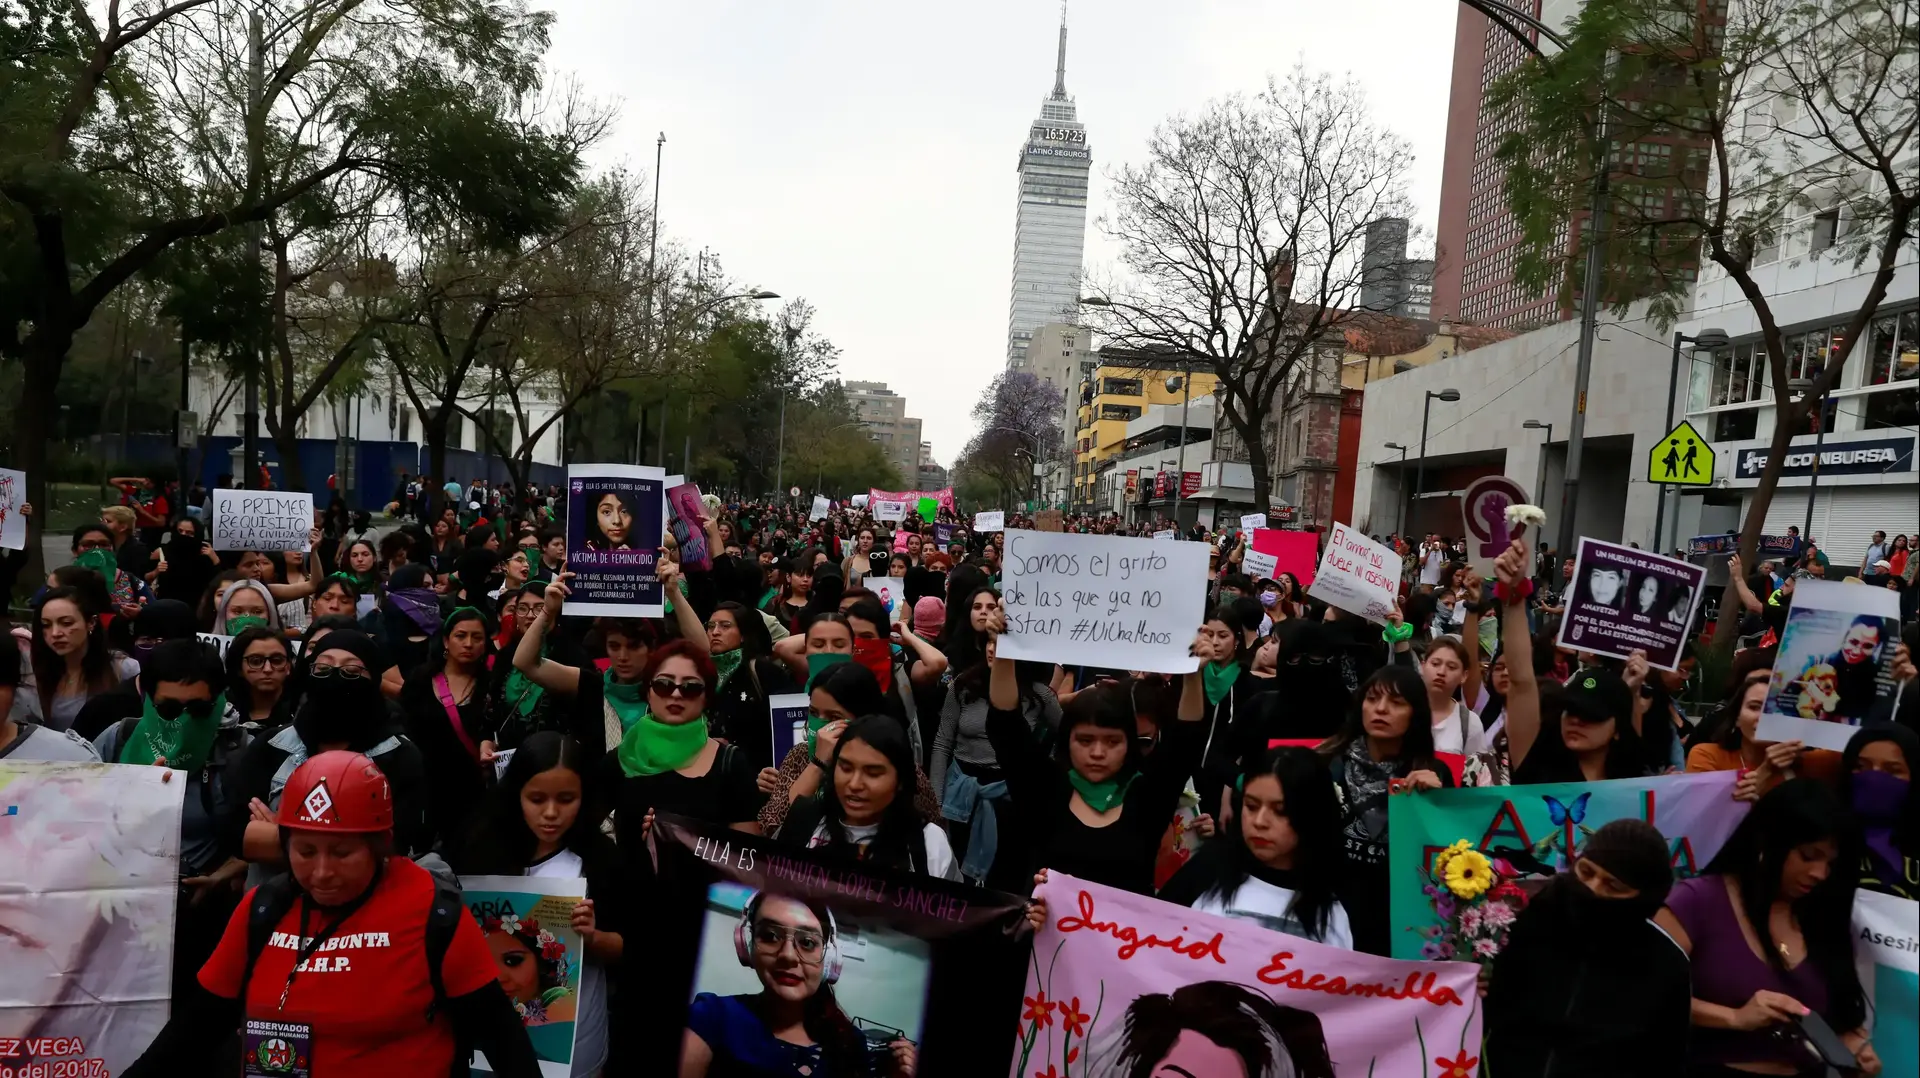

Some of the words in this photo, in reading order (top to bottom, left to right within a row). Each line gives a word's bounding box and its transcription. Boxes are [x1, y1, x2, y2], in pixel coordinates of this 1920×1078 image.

[1045, 128, 1083, 142] 16:57:23
[1028, 147, 1053, 156] LATINO
[1054, 149, 1087, 159] SEGUROS
[1758, 452, 1814, 469] BNCO
[1817, 447, 1897, 466] NBURSA
[220, 499, 234, 514] EL
[243, 497, 308, 515] PRIMER
[218, 515, 306, 532] REQUISITO
[218, 529, 236, 539] DE
[240, 528, 256, 539] LA
[229, 540, 240, 549] ES
[244, 540, 257, 549] LA
[261, 540, 306, 550] JUSTICIA
[1333, 529, 1345, 546] El
[1371, 552, 1383, 567] NO
[572, 551, 597, 564] VÍCTIMA
[600, 553, 608, 564] DE
[612, 553, 653, 565] FEMINICIDIO
[1011, 536, 1079, 576] Somos
[1090, 552, 1110, 577] el
[1119, 551, 1167, 580] grito
[1595, 549, 1607, 559] UN
[1608, 553, 1637, 566] HUELUM
[1638, 559, 1646, 568] DE
[1647, 562, 1676, 576] JUSTICIA
[1677, 569, 1690, 580] PARA
[602, 574, 625, 582] ASESINADA
[1005, 581, 1027, 605] de
[1035, 582, 1062, 607] las
[1073, 590, 1100, 613] que
[1108, 590, 1131, 616] ya
[1141, 590, 1161, 608] no
[1581, 603, 1619, 616] ANAYETZIN
[1573, 614, 1589, 625] POR
[1590, 617, 1598, 626] EL
[1632, 613, 1651, 624] EDITH
[1005, 611, 1061, 635] estan
[1070, 618, 1171, 645] #NiUnaMenos
[1588, 626, 1598, 634] DE
[1598, 628, 1612, 638] LAS
[786, 710, 796, 718] ELLA
[694, 836, 731, 866] ELLA
[737, 848, 757, 872] ES
[765, 854, 830, 890] YUNUEN
[470, 896, 515, 922] ARÍA
[1057, 890, 1227, 965] Ingrid
[1256, 951, 1463, 1006] Escamilla
[246, 1020, 310, 1033] OBSERVADOR
[246, 1029, 278, 1037] DERECHOS
[279, 1031, 309, 1039] HUMANOS
[26, 1037, 84, 1056] VEGA
[18, 1063, 48, 1078] del
[54, 1060, 108, 1078] 2017,
